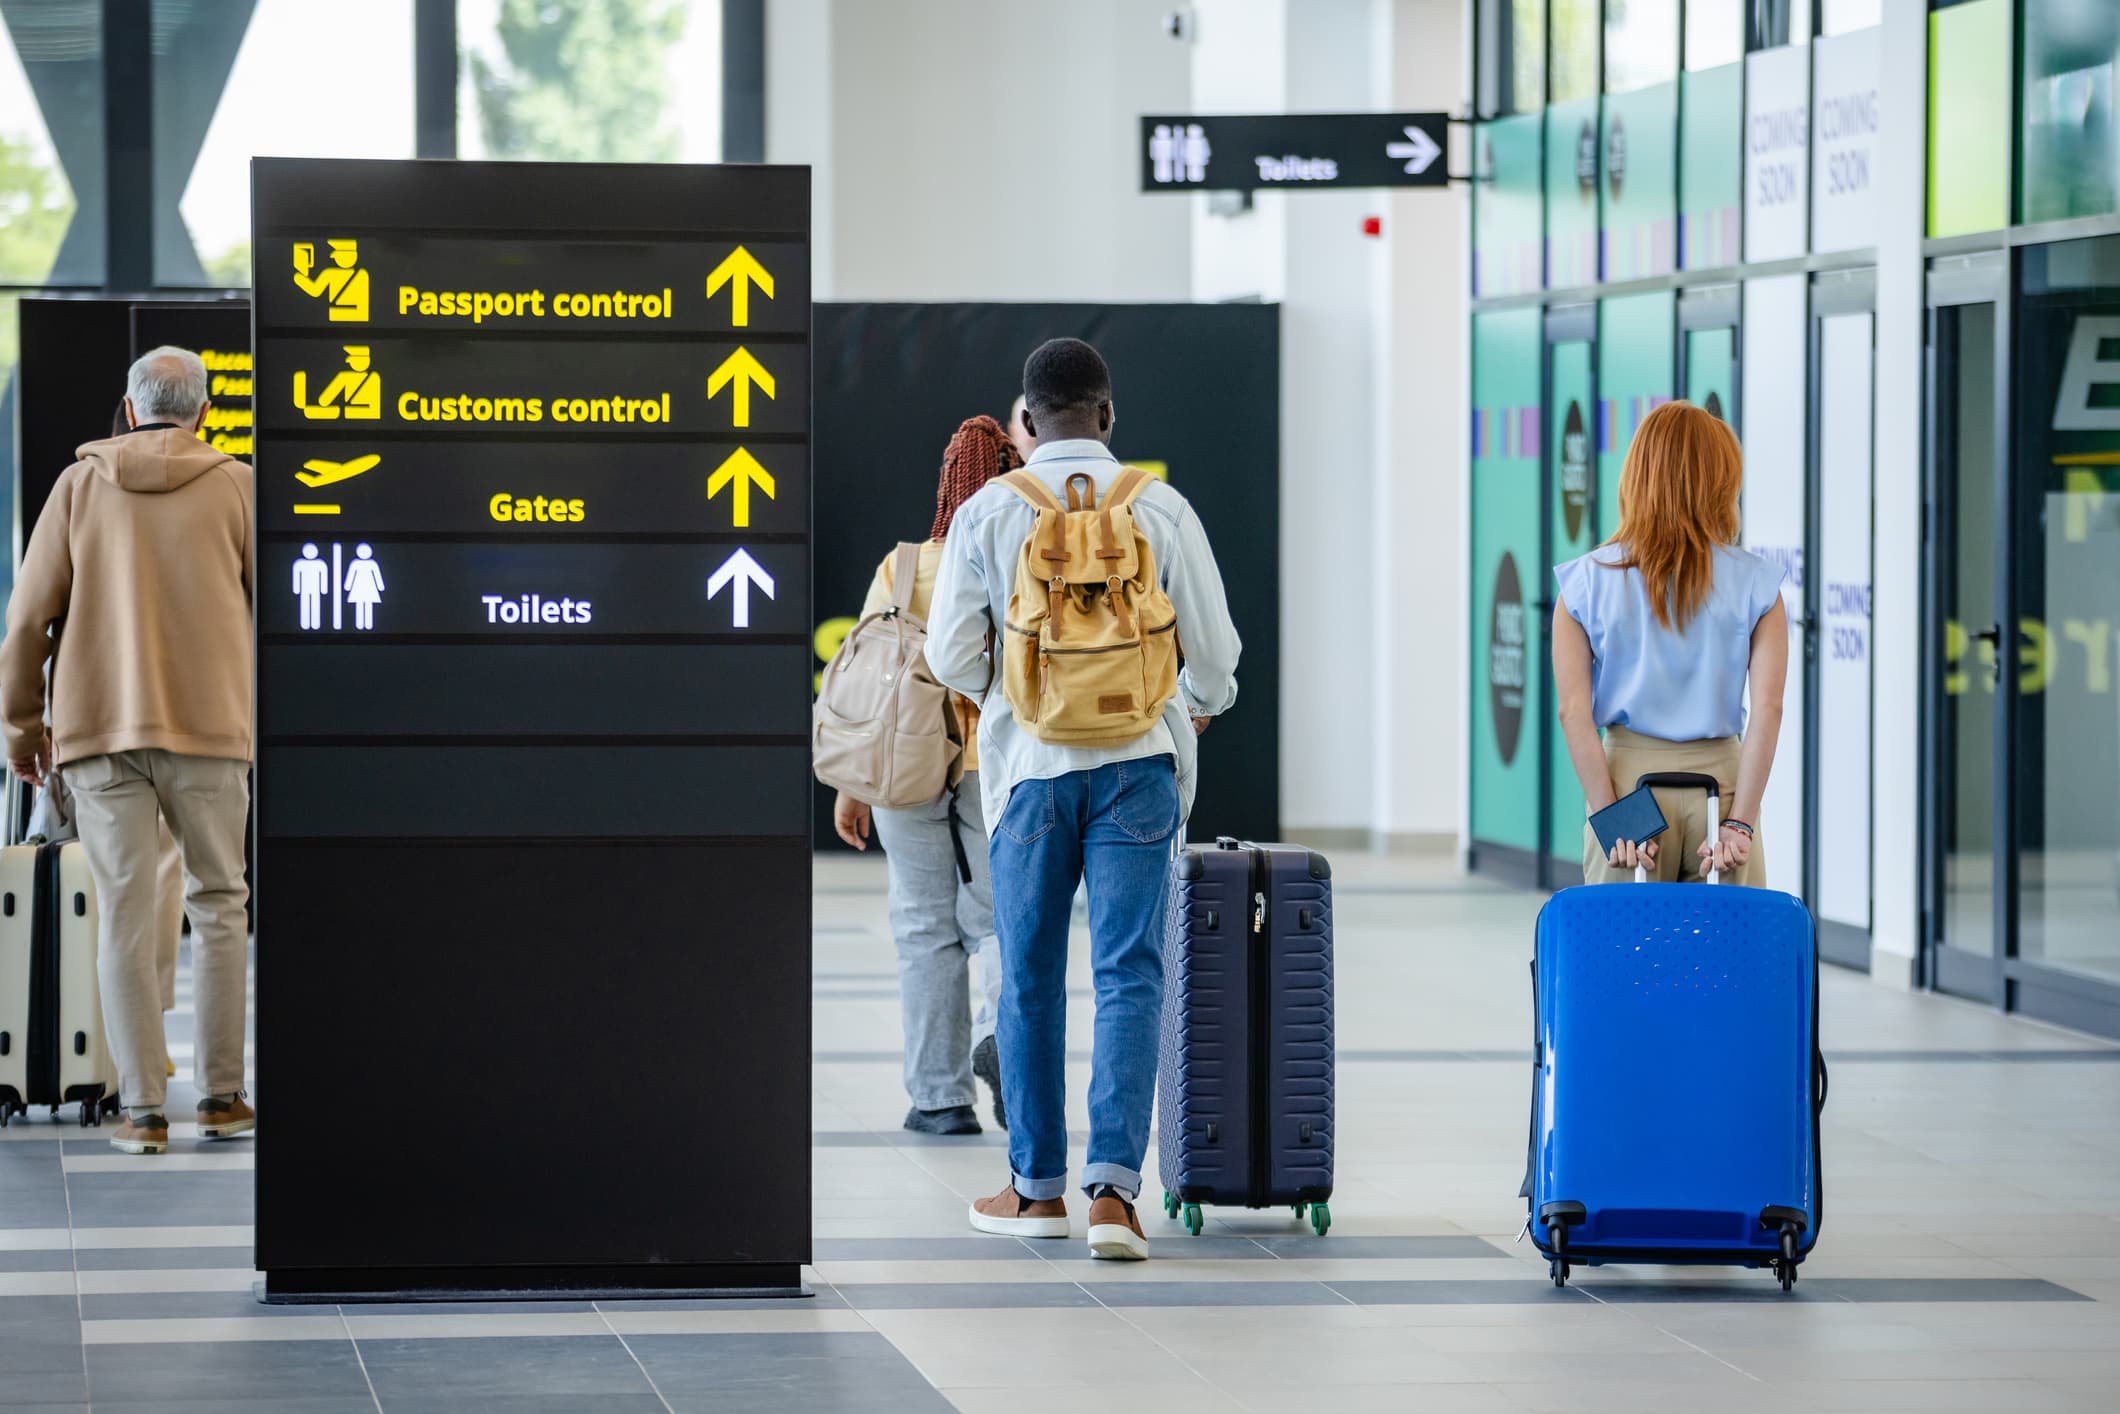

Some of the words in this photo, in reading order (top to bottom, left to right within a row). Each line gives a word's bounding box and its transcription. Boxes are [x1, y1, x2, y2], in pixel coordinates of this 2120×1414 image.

[1255, 156, 1338, 181] Toilets
[1828, 148, 1869, 195] SOON
[398, 285, 545, 323] Passport
[552, 287, 672, 318] control
[397, 391, 544, 422] Customs
[551, 391, 671, 423] control
[489, 492, 586, 523] Gates
[481, 594, 592, 624] Toilets
[1832, 627, 1865, 661] SOON
